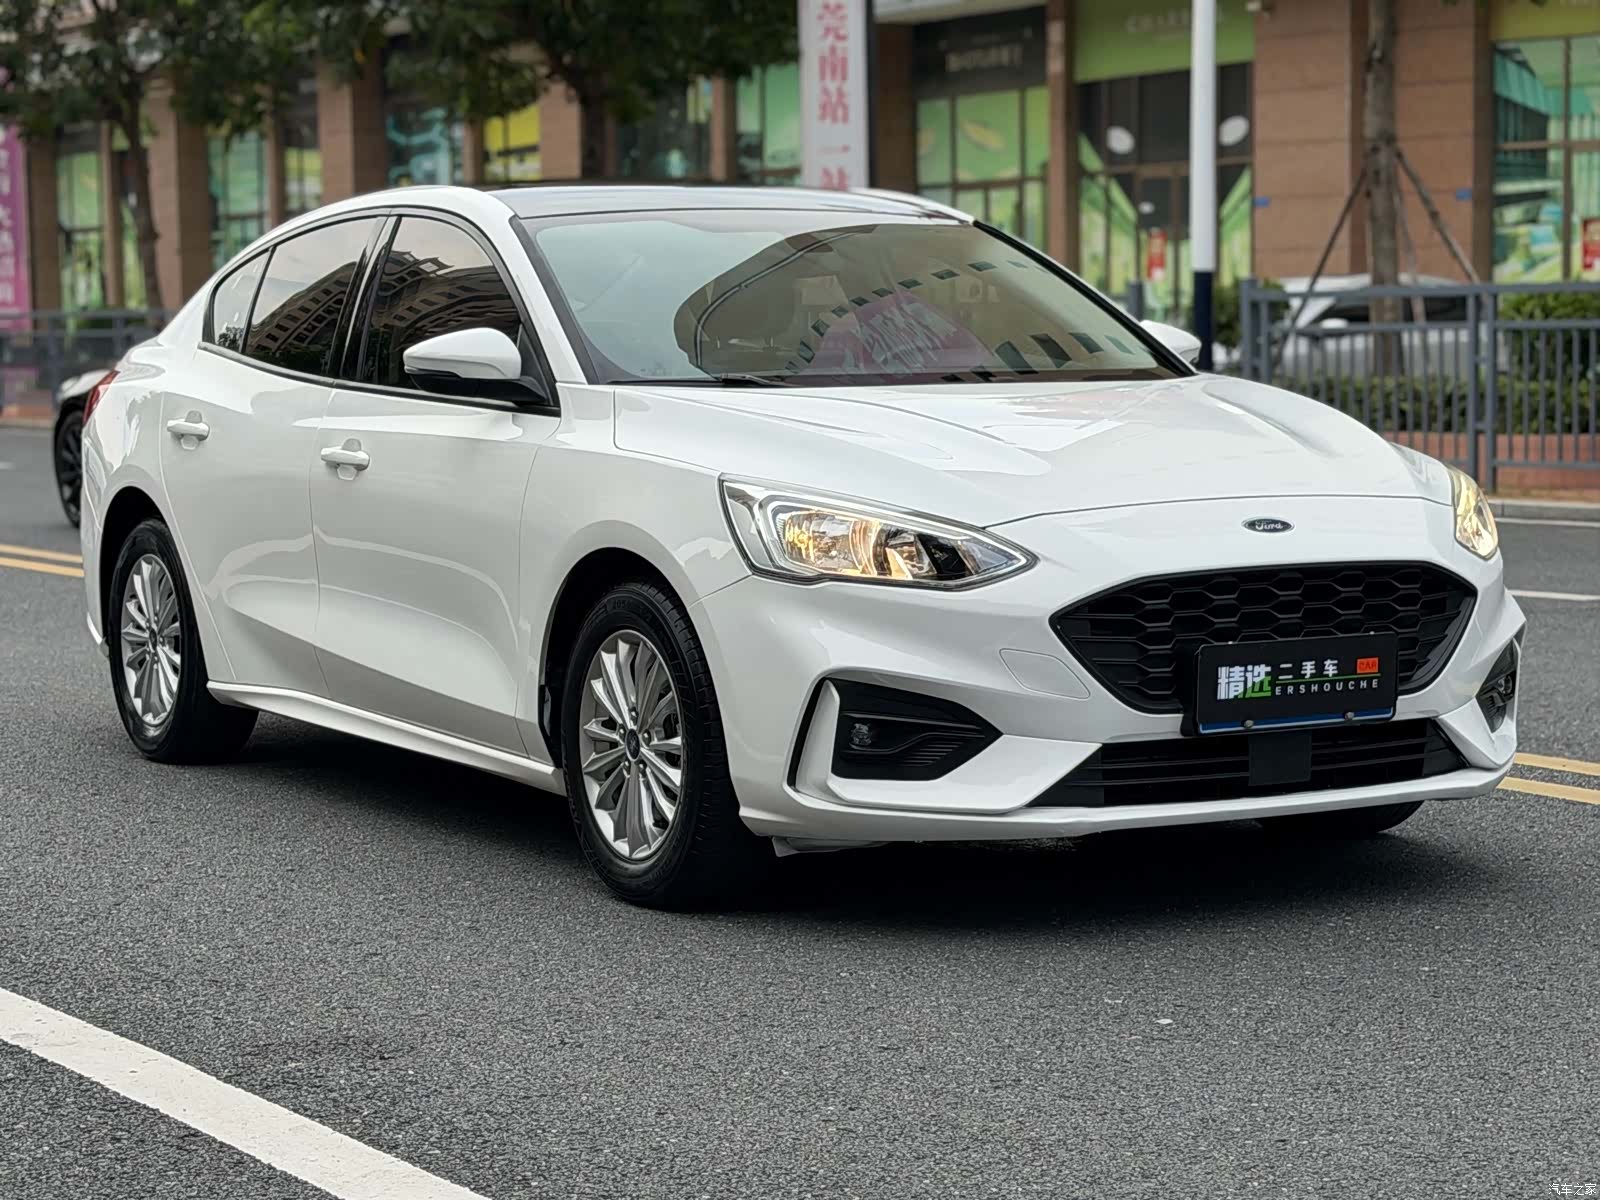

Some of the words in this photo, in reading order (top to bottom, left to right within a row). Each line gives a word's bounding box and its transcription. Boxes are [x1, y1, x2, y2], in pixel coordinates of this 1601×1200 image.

[1278, 659, 1339, 679] 二手车
[1217, 664, 1272, 700] 精选
[1275, 679, 1378, 695] ERSHOUCHE
